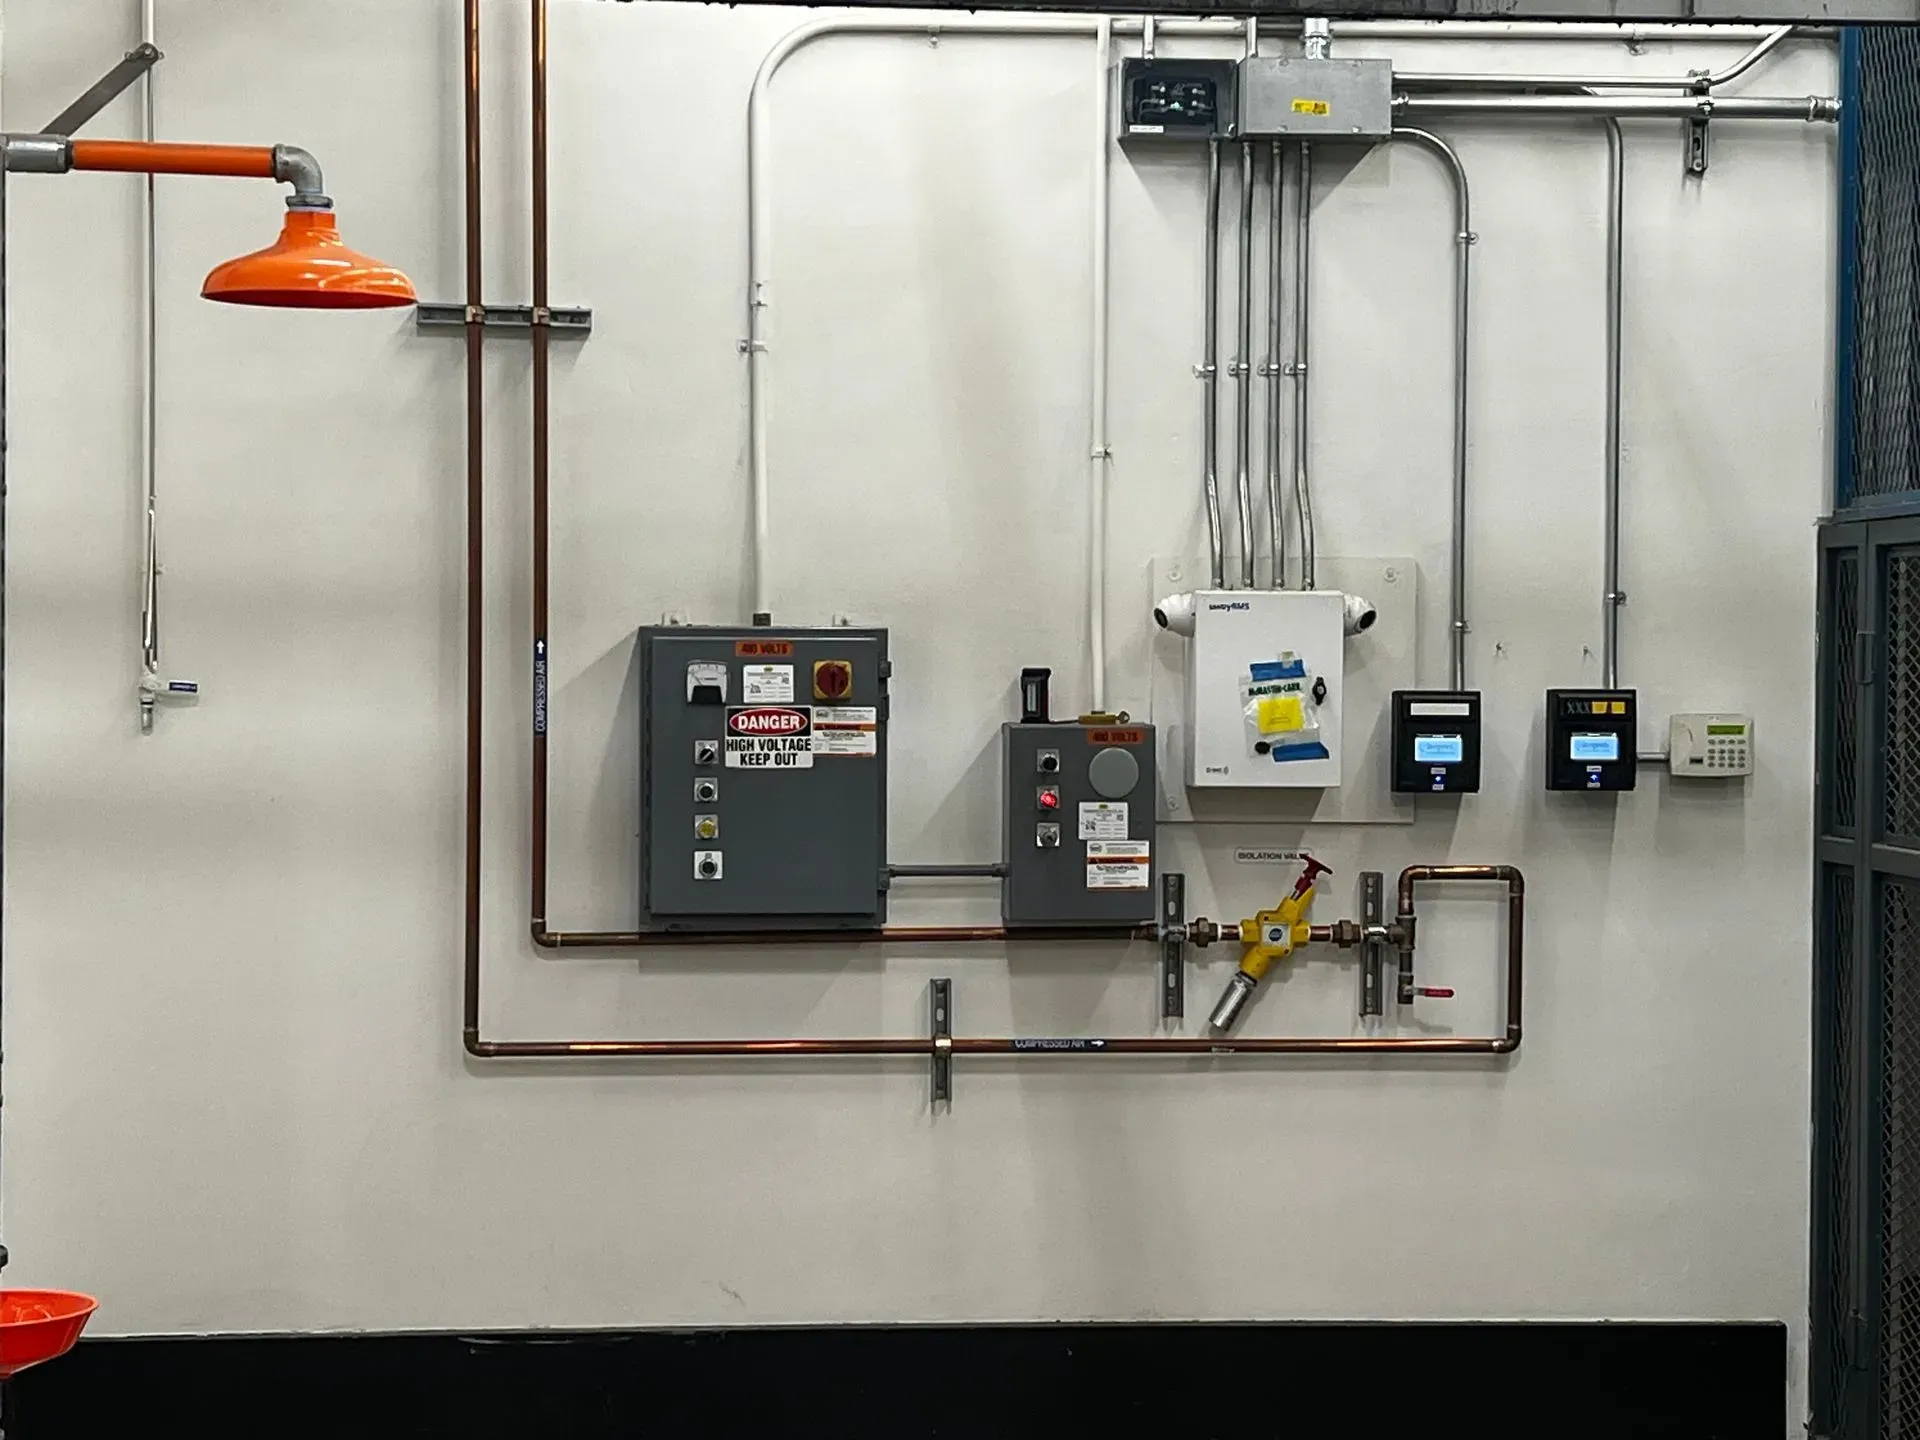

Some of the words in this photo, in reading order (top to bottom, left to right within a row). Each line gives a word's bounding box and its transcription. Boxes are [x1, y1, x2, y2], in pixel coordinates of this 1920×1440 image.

[760, 643, 789, 655] VOLTS
[535, 660, 545, 675] AIR
[535, 675, 545, 732] COMPRESSED
[738, 715, 800, 730] DANGER
[726, 738, 755, 752] HIGH
[758, 738, 812, 752] VOLTAGE
[740, 752, 771, 766] KEEP
[774, 752, 799, 766] OUT
[1238, 852, 1282, 860] ISOLATION
[1015, 1040, 1070, 1048] COMPRESSED
[1071, 1040, 1085, 1048] AIR
